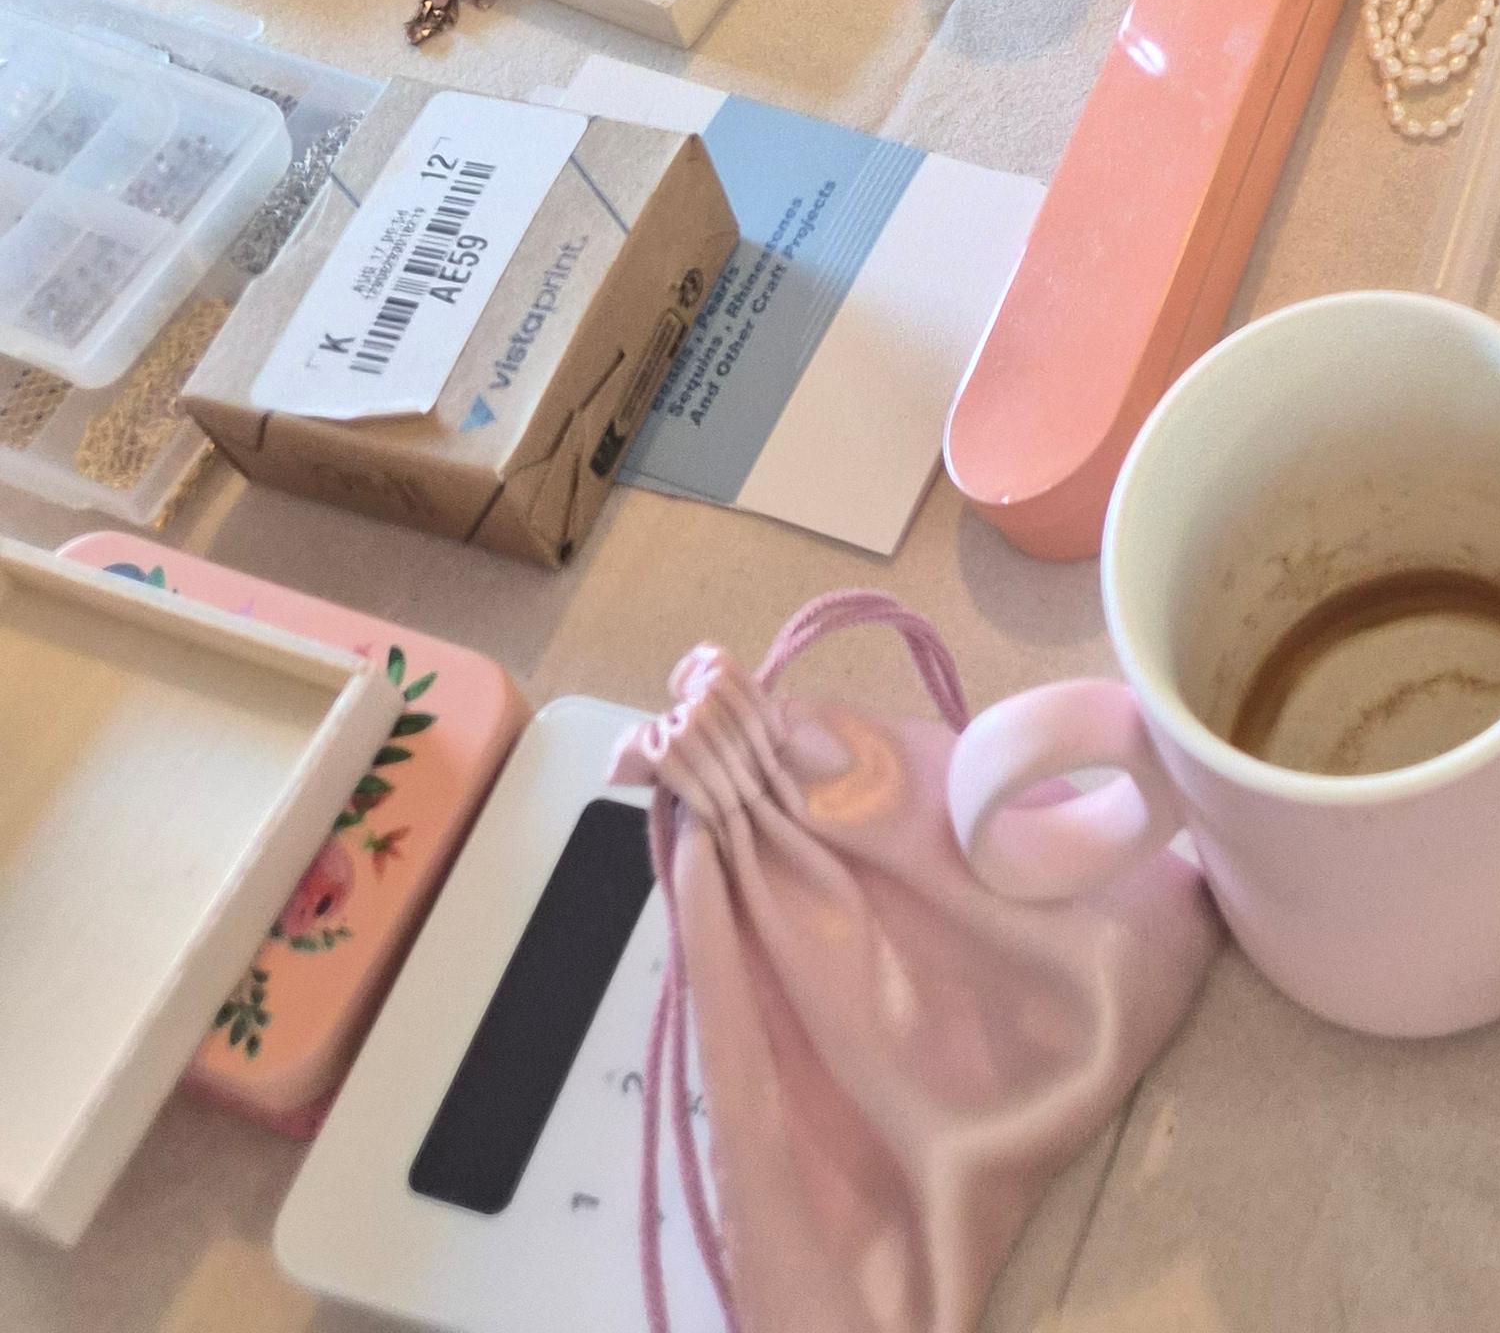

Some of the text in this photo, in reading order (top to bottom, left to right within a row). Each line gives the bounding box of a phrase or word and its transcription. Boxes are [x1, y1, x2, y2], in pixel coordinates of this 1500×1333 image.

[420, 153, 458, 184] 12
[434, 235, 488, 304] AE59
[684, 175, 839, 427] And Other Craft Projects
[665, 192, 803, 420] Sequins Rhinestones
[318, 332, 353, 370] K
